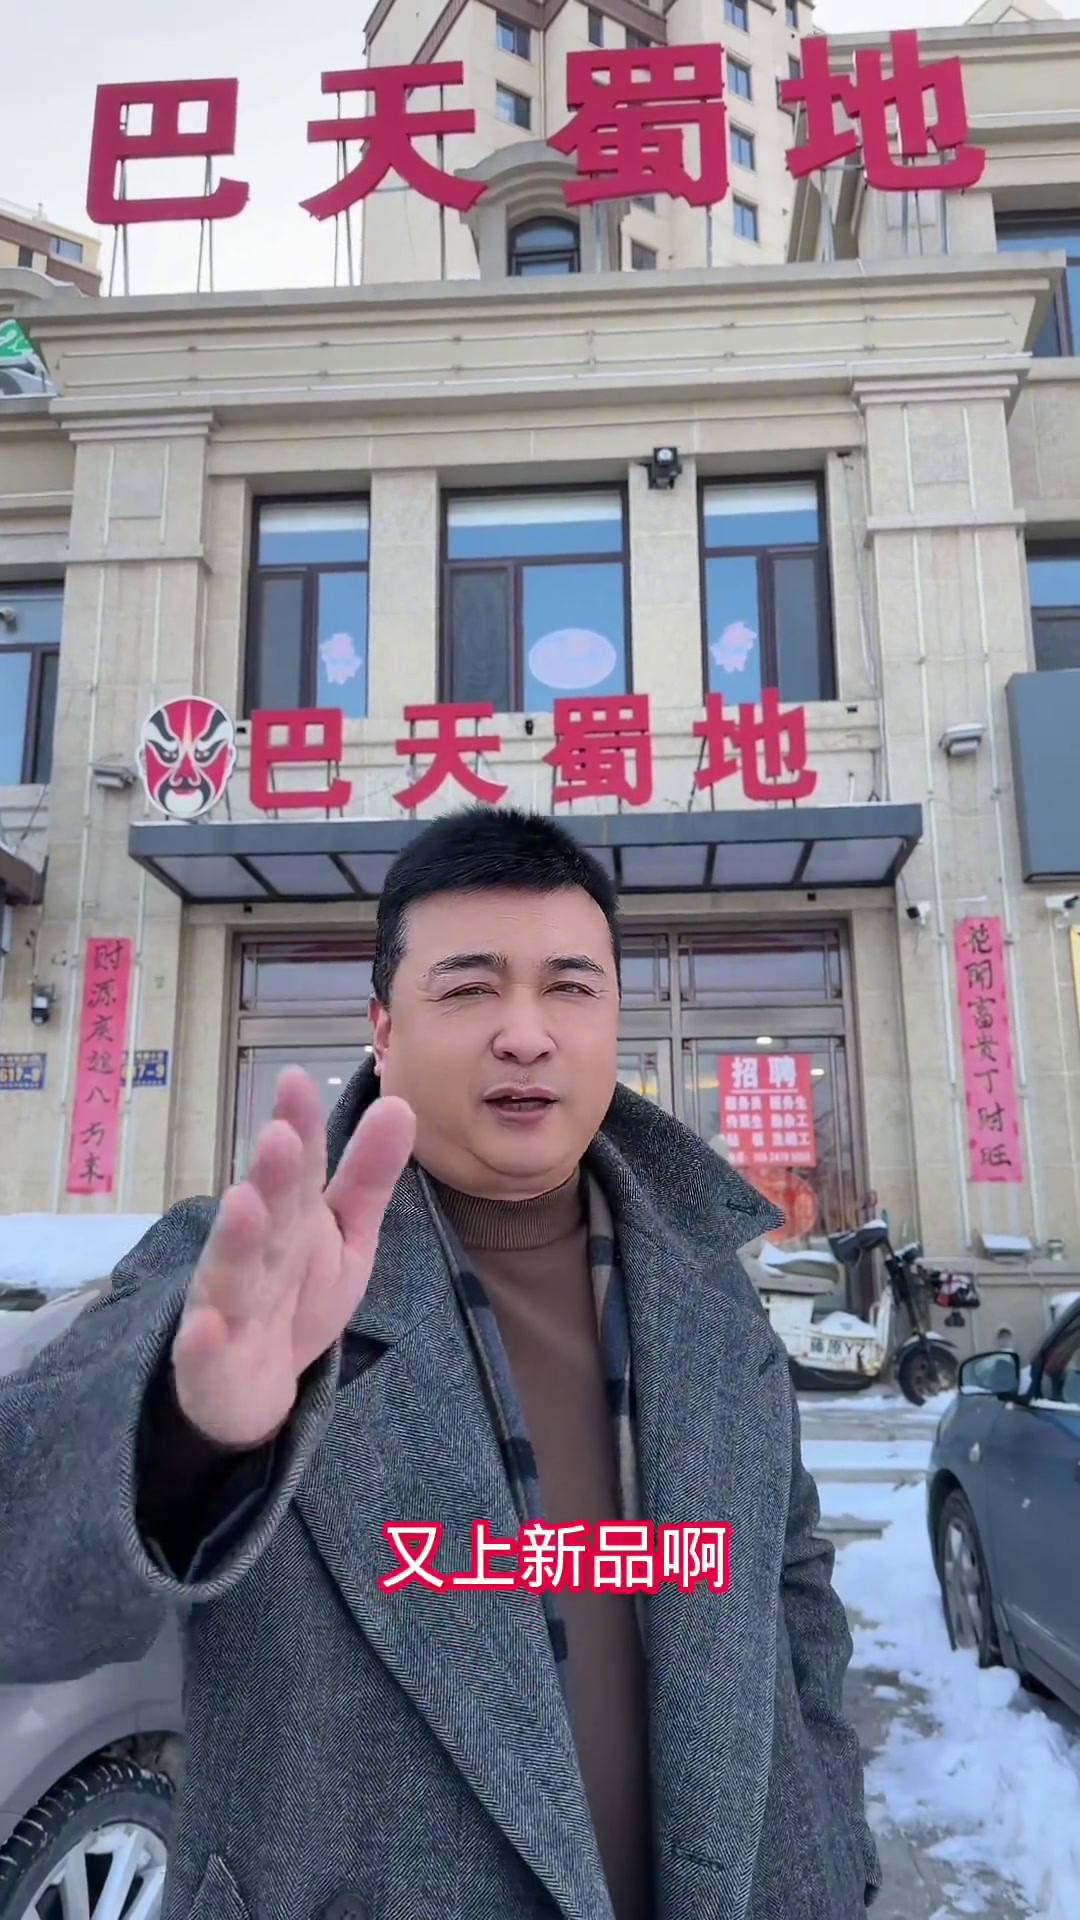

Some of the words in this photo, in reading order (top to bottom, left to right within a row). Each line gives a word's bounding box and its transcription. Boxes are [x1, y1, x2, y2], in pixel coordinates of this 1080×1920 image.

[86, 29, 986, 225] 巴天蜀地
[247, 687, 817, 809] 巴天蜀地
[731, 1056, 796, 1089] 招聘
